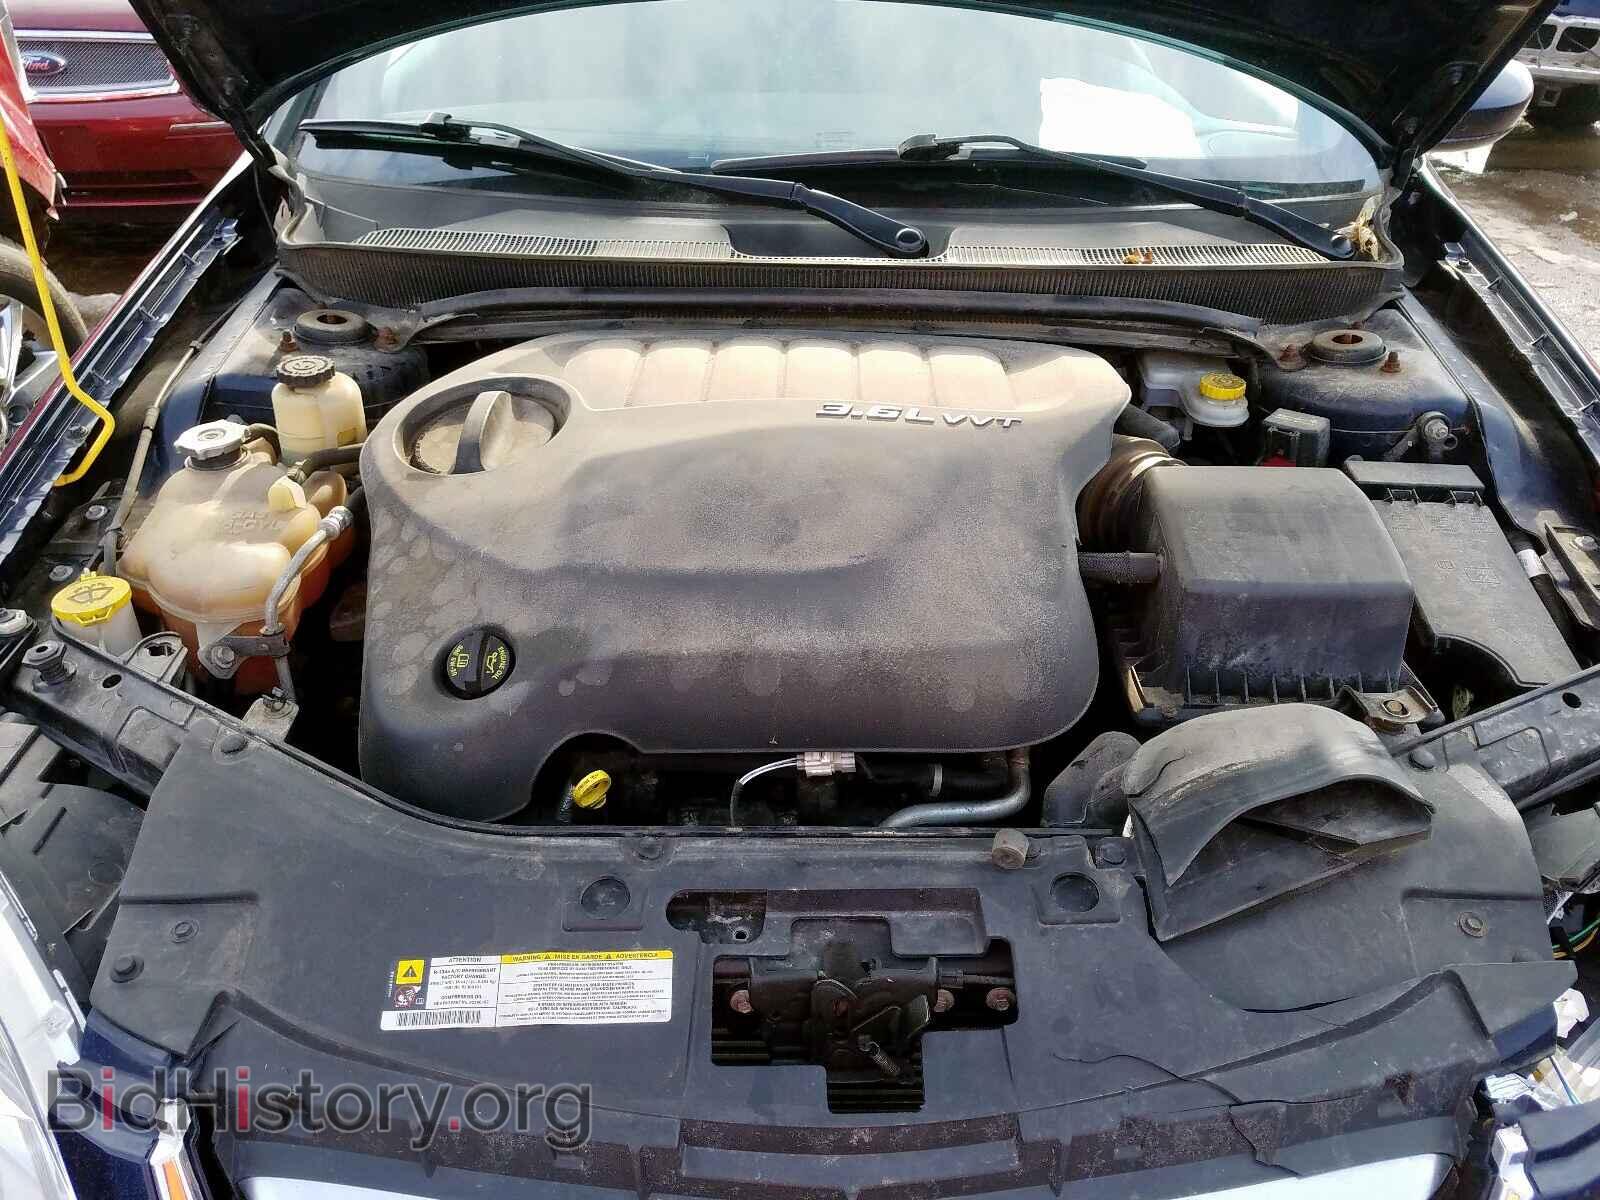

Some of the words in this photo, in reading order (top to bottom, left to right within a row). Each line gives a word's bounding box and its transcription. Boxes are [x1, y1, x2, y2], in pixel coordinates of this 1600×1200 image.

[22, 56, 50, 70] Ford
[816, 402, 935, 425] 3.6L
[942, 413, 1024, 429] VVT
[498, 646, 508, 670] ENGINE
[491, 669, 503, 680] OIL
[512, 954, 541, 962] WARNING
